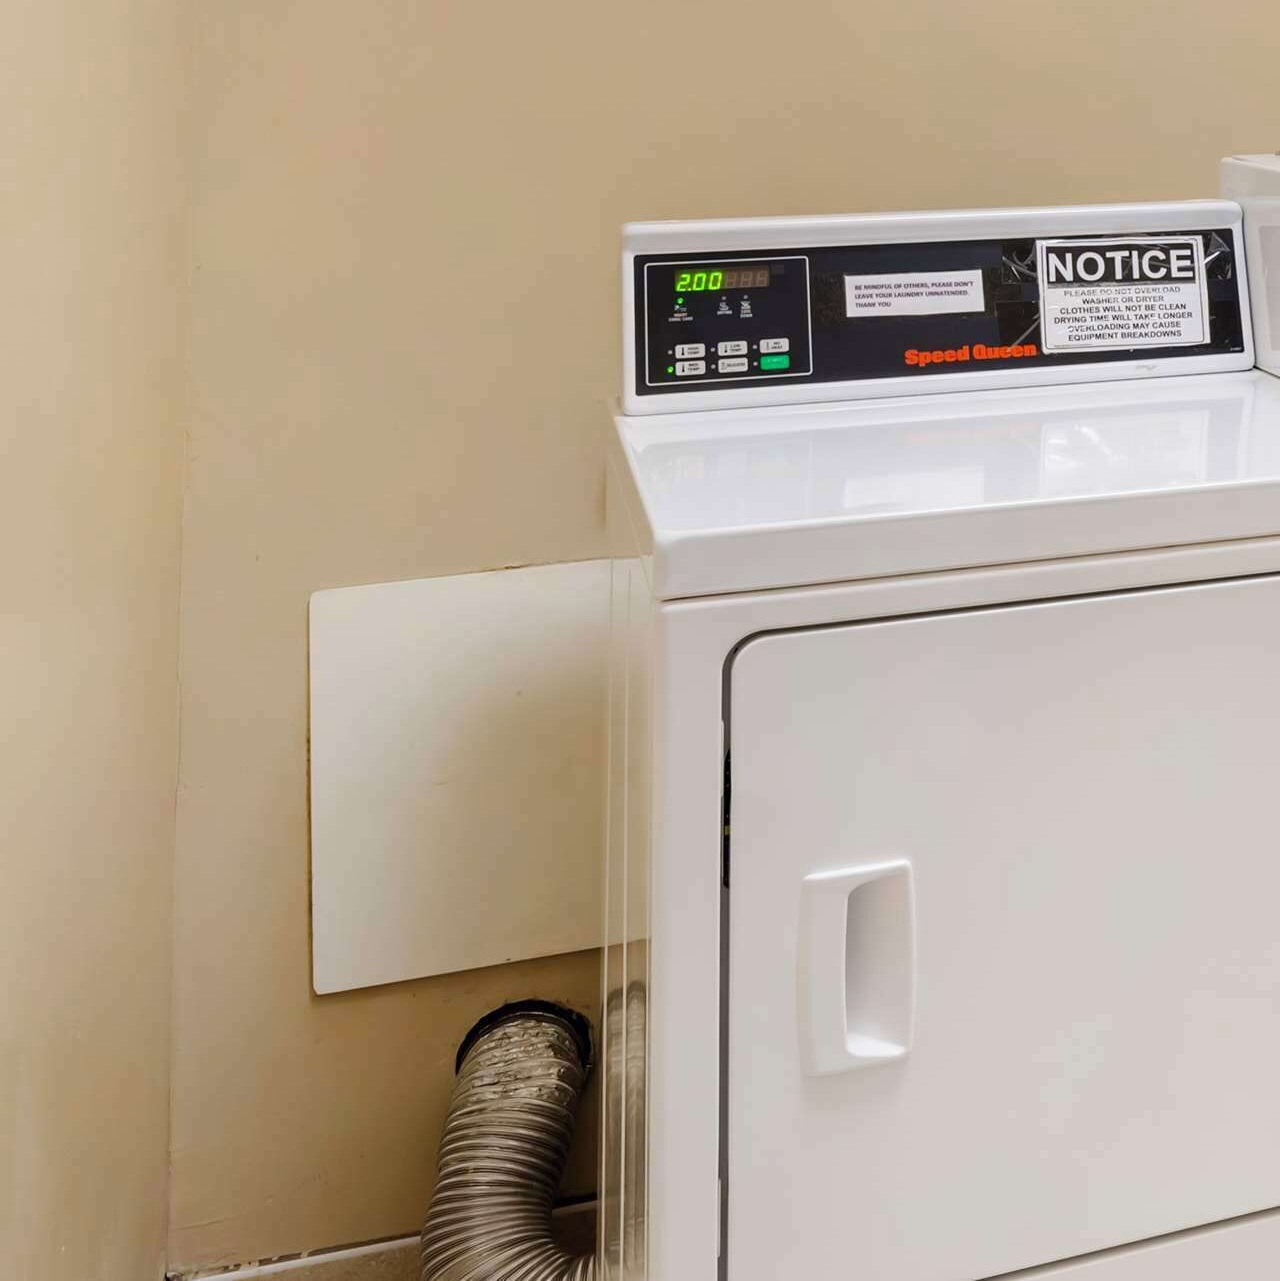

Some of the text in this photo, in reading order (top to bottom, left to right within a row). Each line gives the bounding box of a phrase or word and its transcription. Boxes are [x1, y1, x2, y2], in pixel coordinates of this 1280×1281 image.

[1047, 249, 1194, 282] NOTICE
[675, 271, 723, 292] 2.00
[1134, 286, 1181, 295] OVERLOAD
[1082, 297, 1119, 305] WASHER
[1135, 295, 1164, 303] DRYER
[1060, 306, 1100, 315] CLOTHES
[1102, 305, 1123, 313] WILL
[1125, 304, 1142, 312] NOT
[1157, 303, 1187, 311] CLEAN
[1054, 315, 1087, 324] DRYING
[1157, 312, 1193, 320] LONGER
[1067, 322, 1130, 333] OVERLOADING
[1152, 321, 1181, 329] CAUSE
[1068, 330, 1182, 342] EQUIPMENT BREAKDOWNS
[904, 343, 1037, 367] Speed Queen
